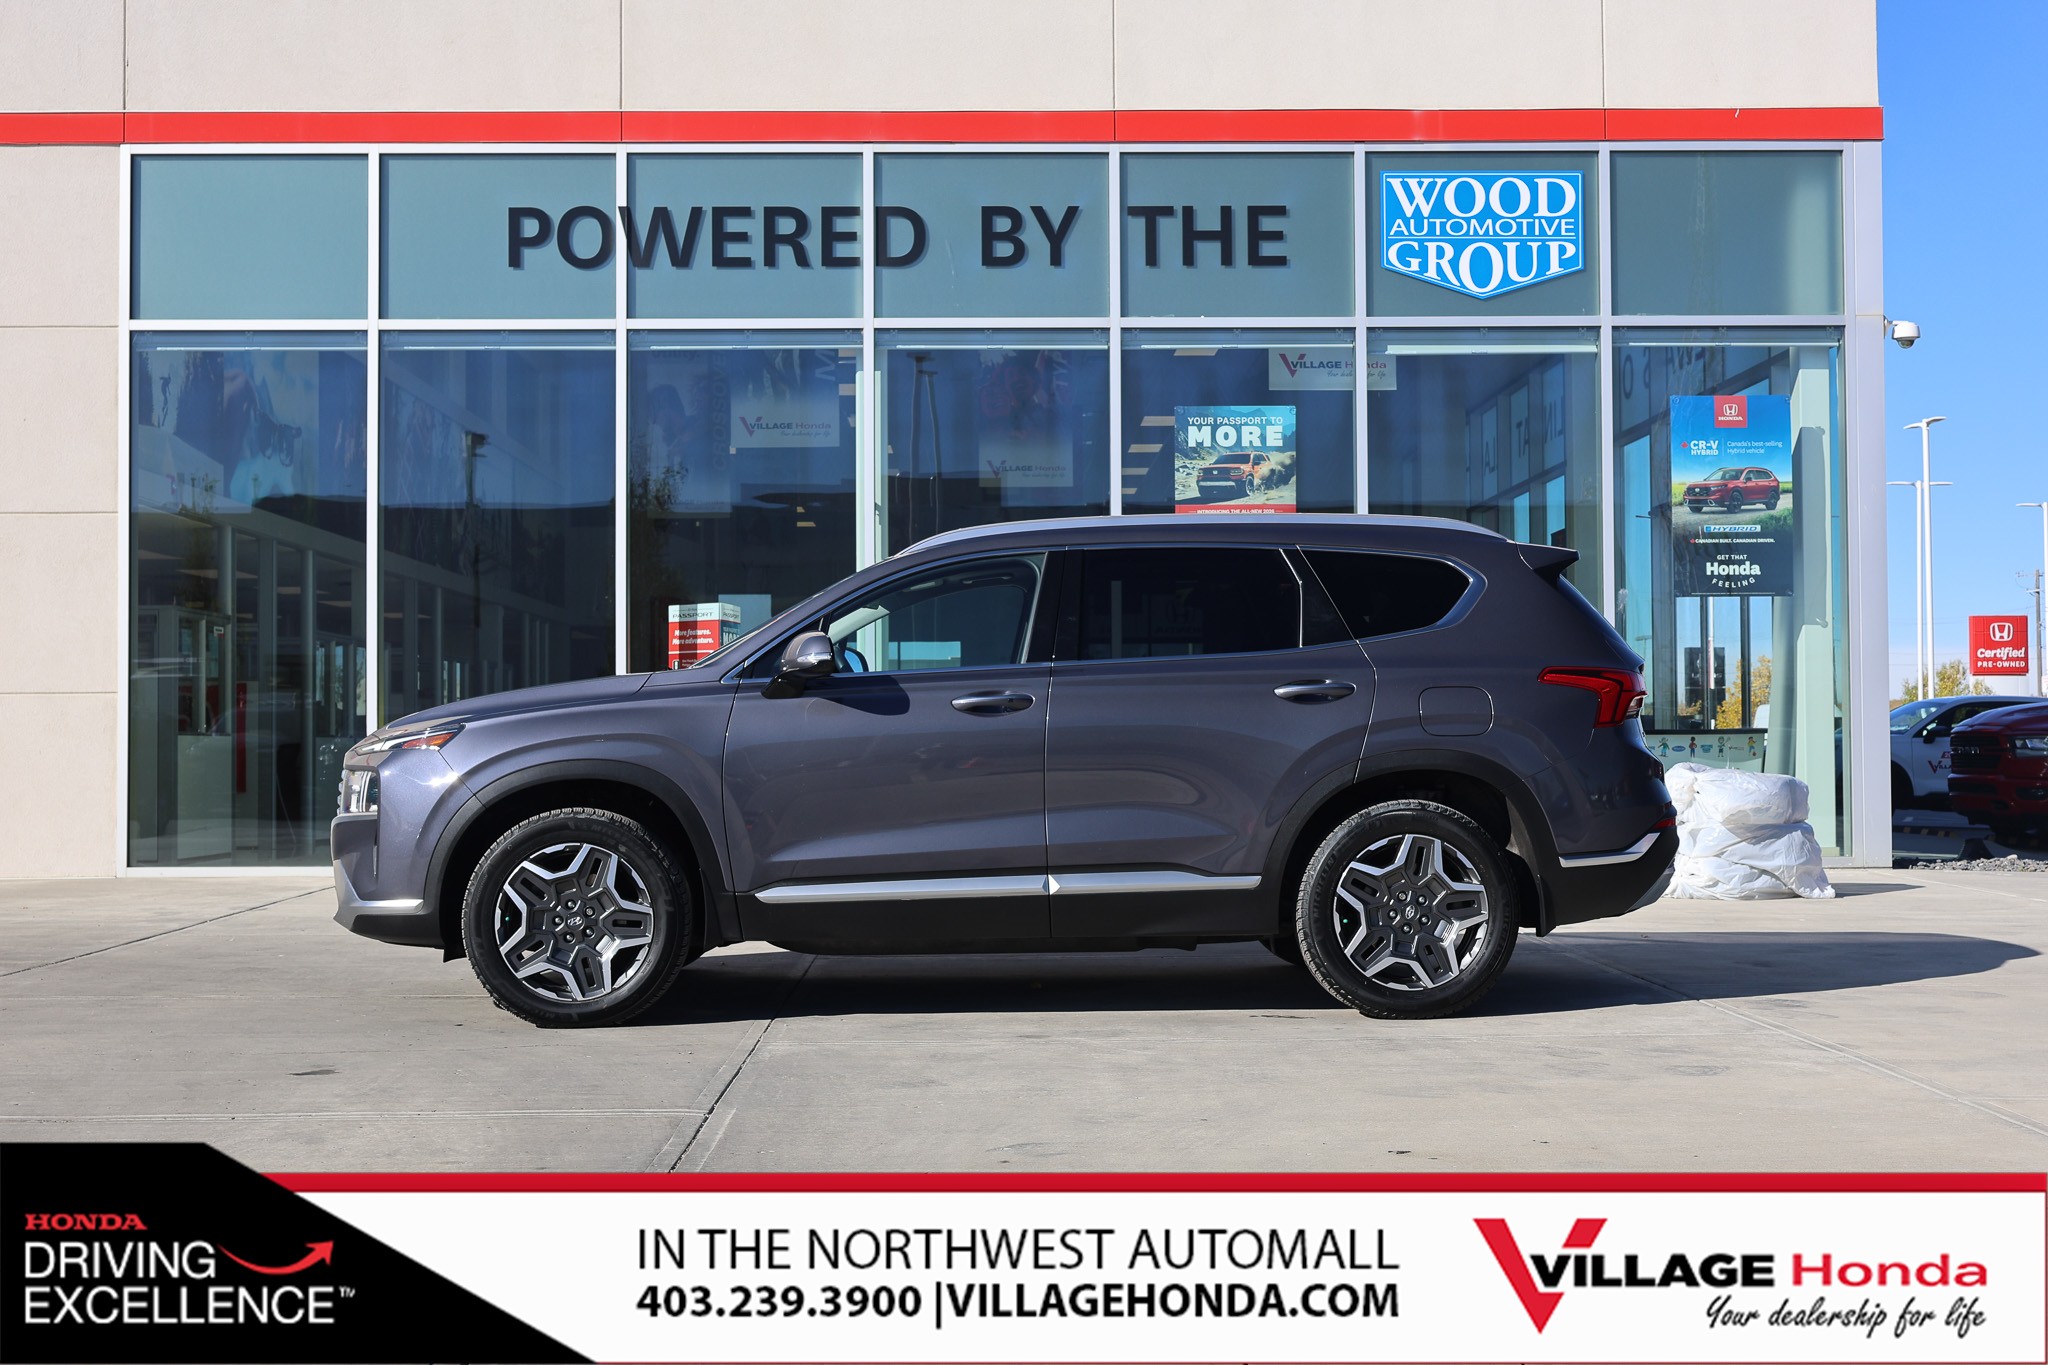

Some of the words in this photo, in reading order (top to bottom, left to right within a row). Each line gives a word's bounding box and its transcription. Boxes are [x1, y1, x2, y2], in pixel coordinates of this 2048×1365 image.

[1387, 177, 1576, 217] WOOD
[1389, 219, 1575, 235] AUTOMOTIVE
[508, 206, 927, 269] POWERED
[981, 205, 1080, 267] BY
[1127, 205, 1288, 267] THE
[1388, 241, 1576, 293] GROUP
[1187, 425, 1283, 447] MORE
[1690, 440, 1718, 449] CR-V
[1706, 561, 1761, 576] Honda
[1711, 576, 1756, 588] FEELING
[1977, 647, 2025, 660] Certified
